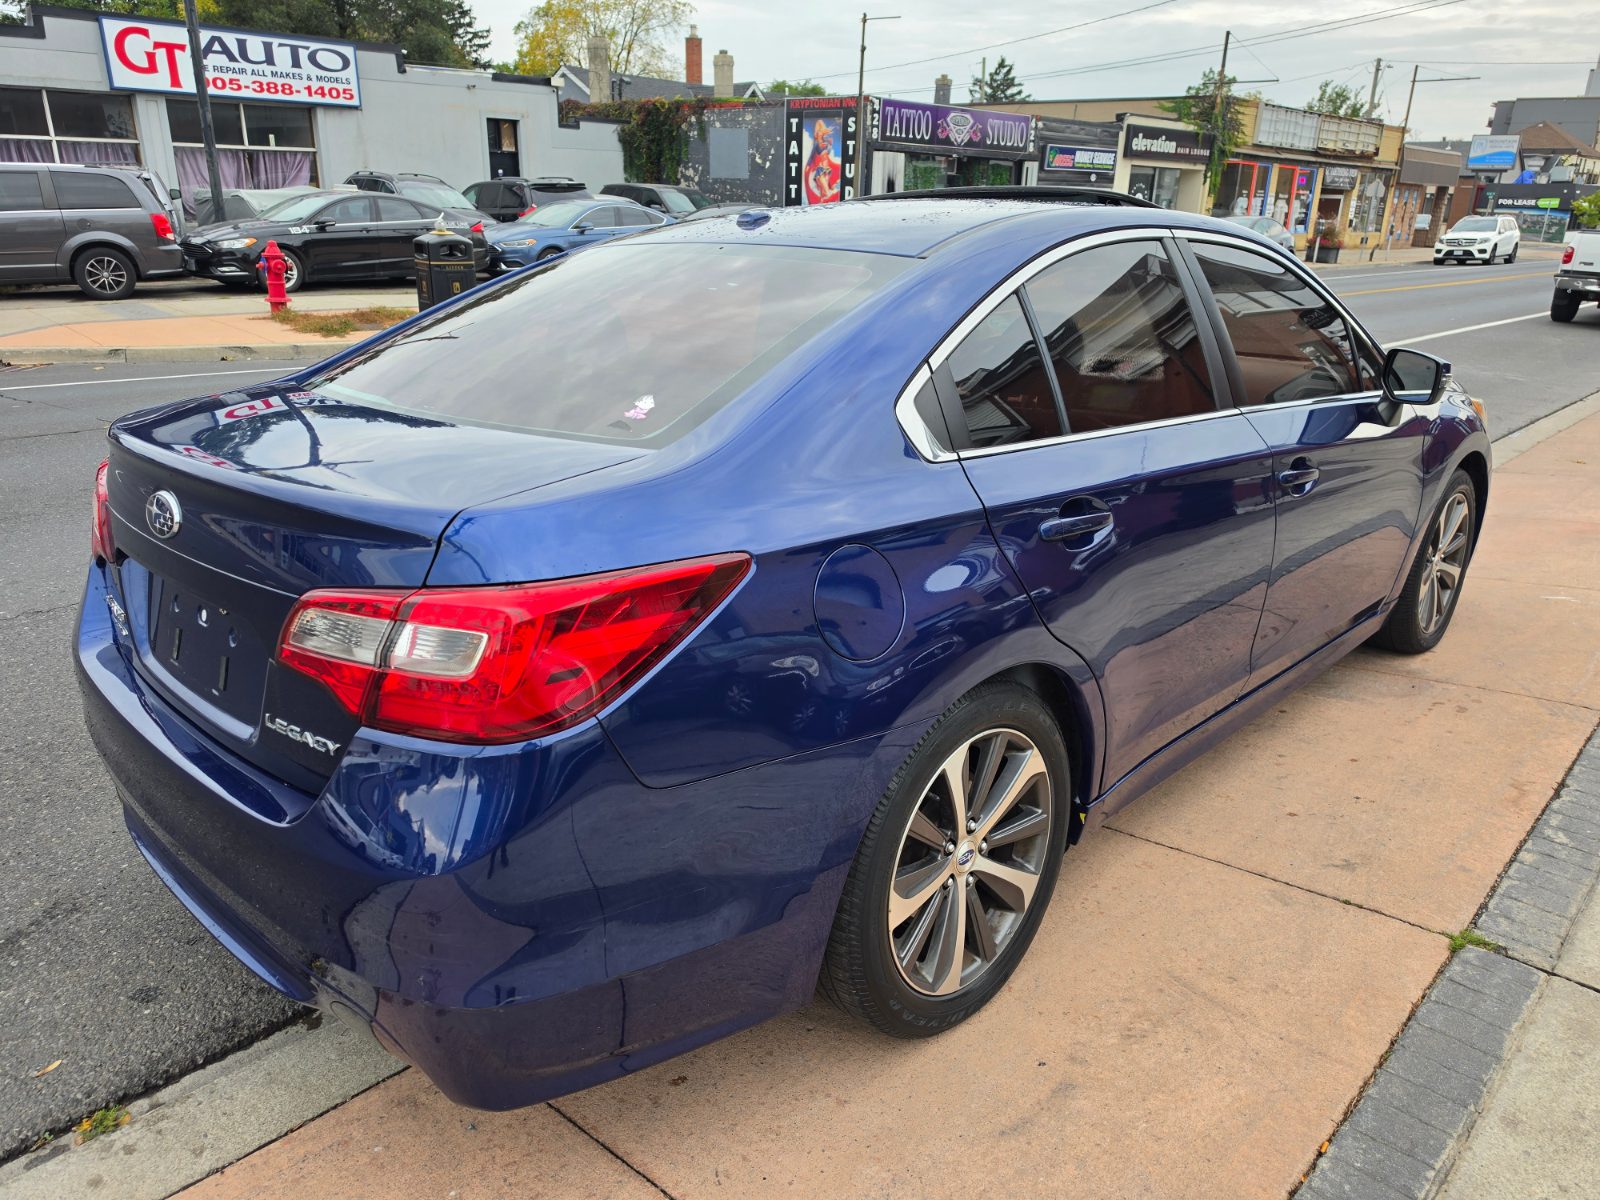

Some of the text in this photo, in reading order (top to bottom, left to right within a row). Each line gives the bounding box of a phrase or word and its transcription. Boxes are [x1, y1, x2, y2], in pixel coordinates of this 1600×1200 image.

[114, 27, 351, 88] GT AUTO
[213, 65, 248, 75] REPAIR
[251, 69, 268, 77] ALL
[271, 70, 304, 80] MAKES
[316, 75, 351, 85] MODELS
[885, 107, 1027, 147] TATTOO STUDIO
[1132, 132, 1176, 153] elevation
[265, 713, 341, 756] LEGACY
